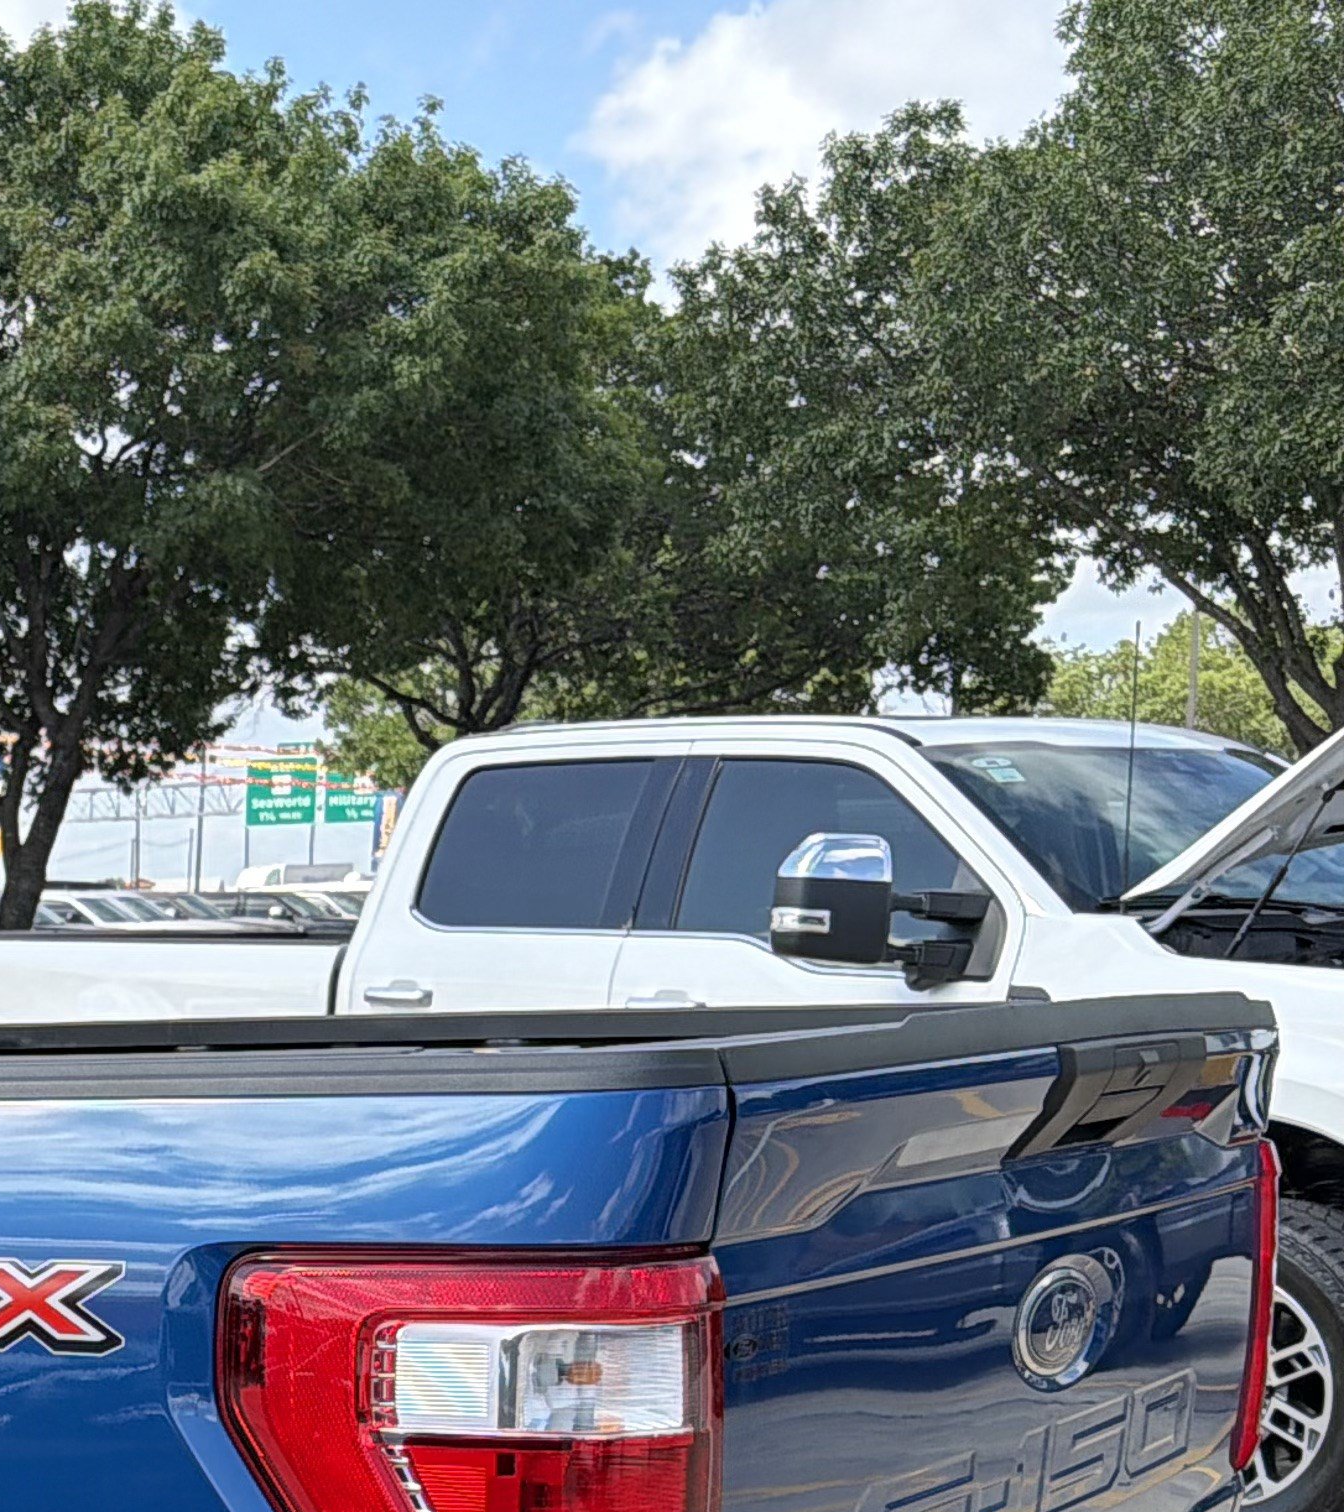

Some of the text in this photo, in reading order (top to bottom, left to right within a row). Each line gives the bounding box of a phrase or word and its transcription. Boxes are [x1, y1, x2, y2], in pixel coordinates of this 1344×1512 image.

[251, 796, 311, 809] SeaWorld
[328, 795, 377, 808] Military
[1045, 1291, 1086, 1351] Ford
